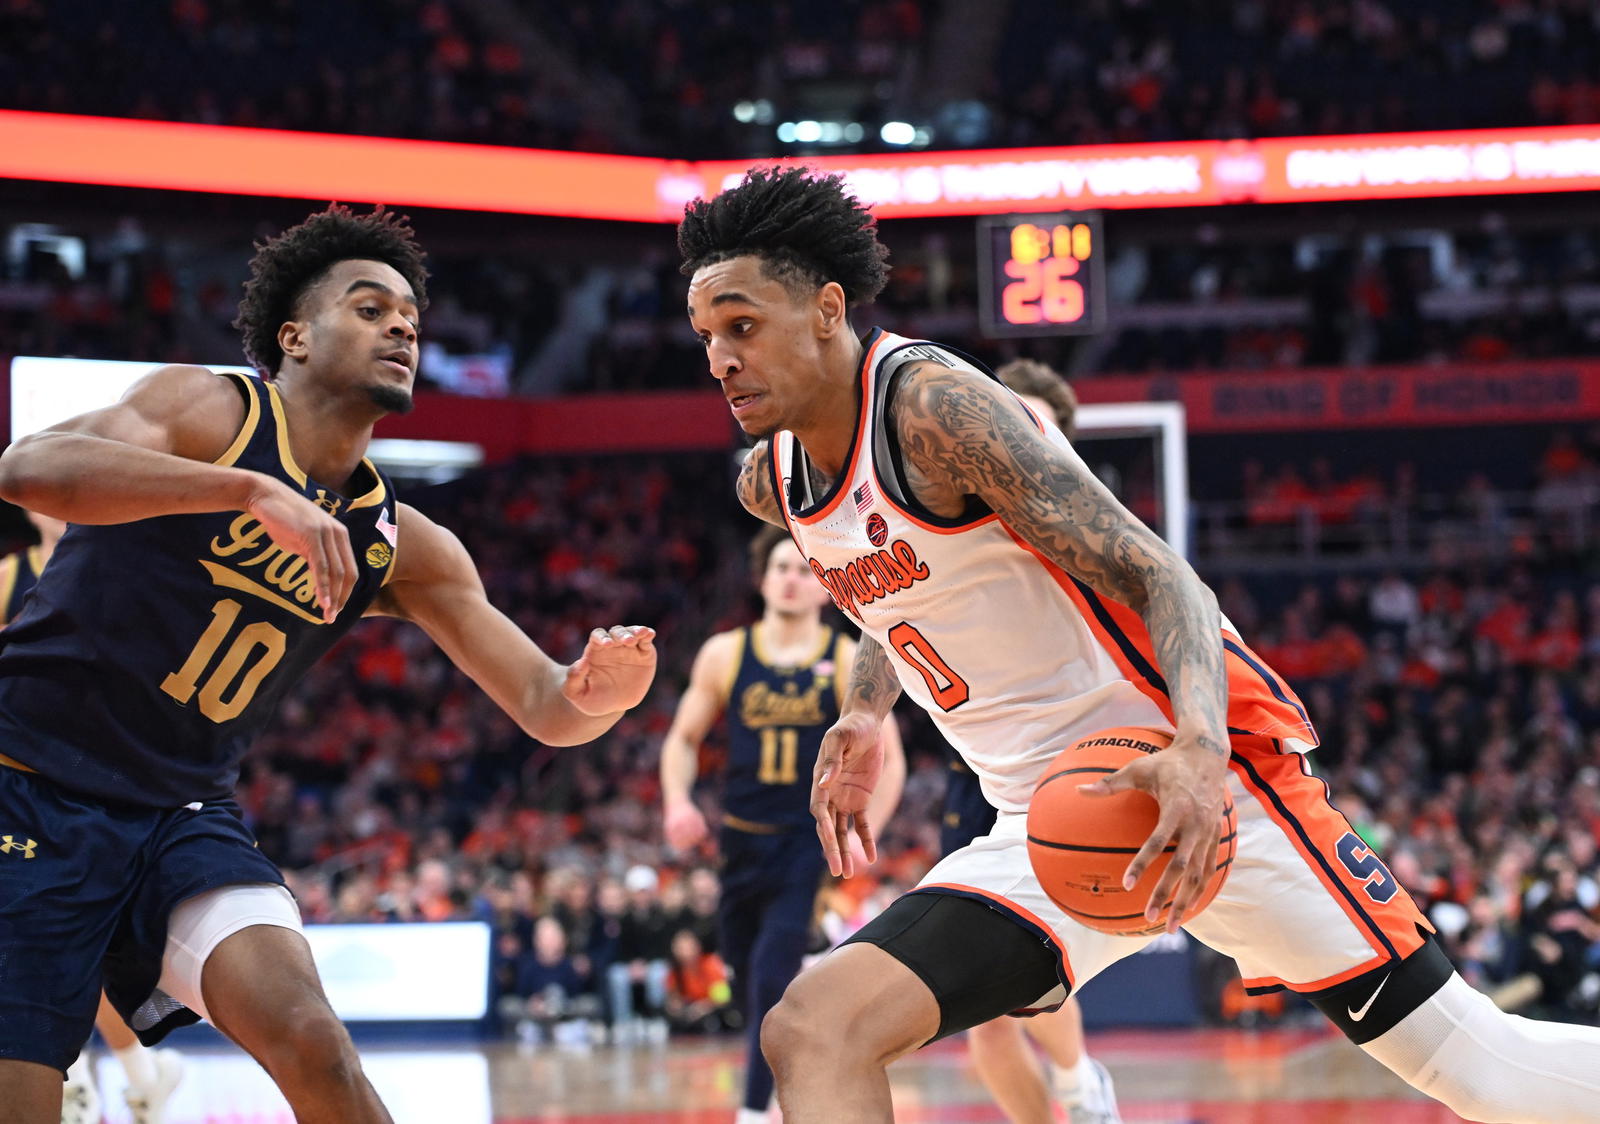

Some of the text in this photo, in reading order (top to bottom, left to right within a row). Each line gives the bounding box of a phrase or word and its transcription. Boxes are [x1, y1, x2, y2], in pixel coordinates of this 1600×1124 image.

[1003, 257, 1084, 324] 26
[809, 539, 930, 624] Syracuse
[160, 598, 286, 724] 10
[888, 621, 969, 713] 0
[758, 727, 798, 785] 11
[1075, 737, 1162, 754] SYRACUSE
[1335, 831, 1399, 904] S
